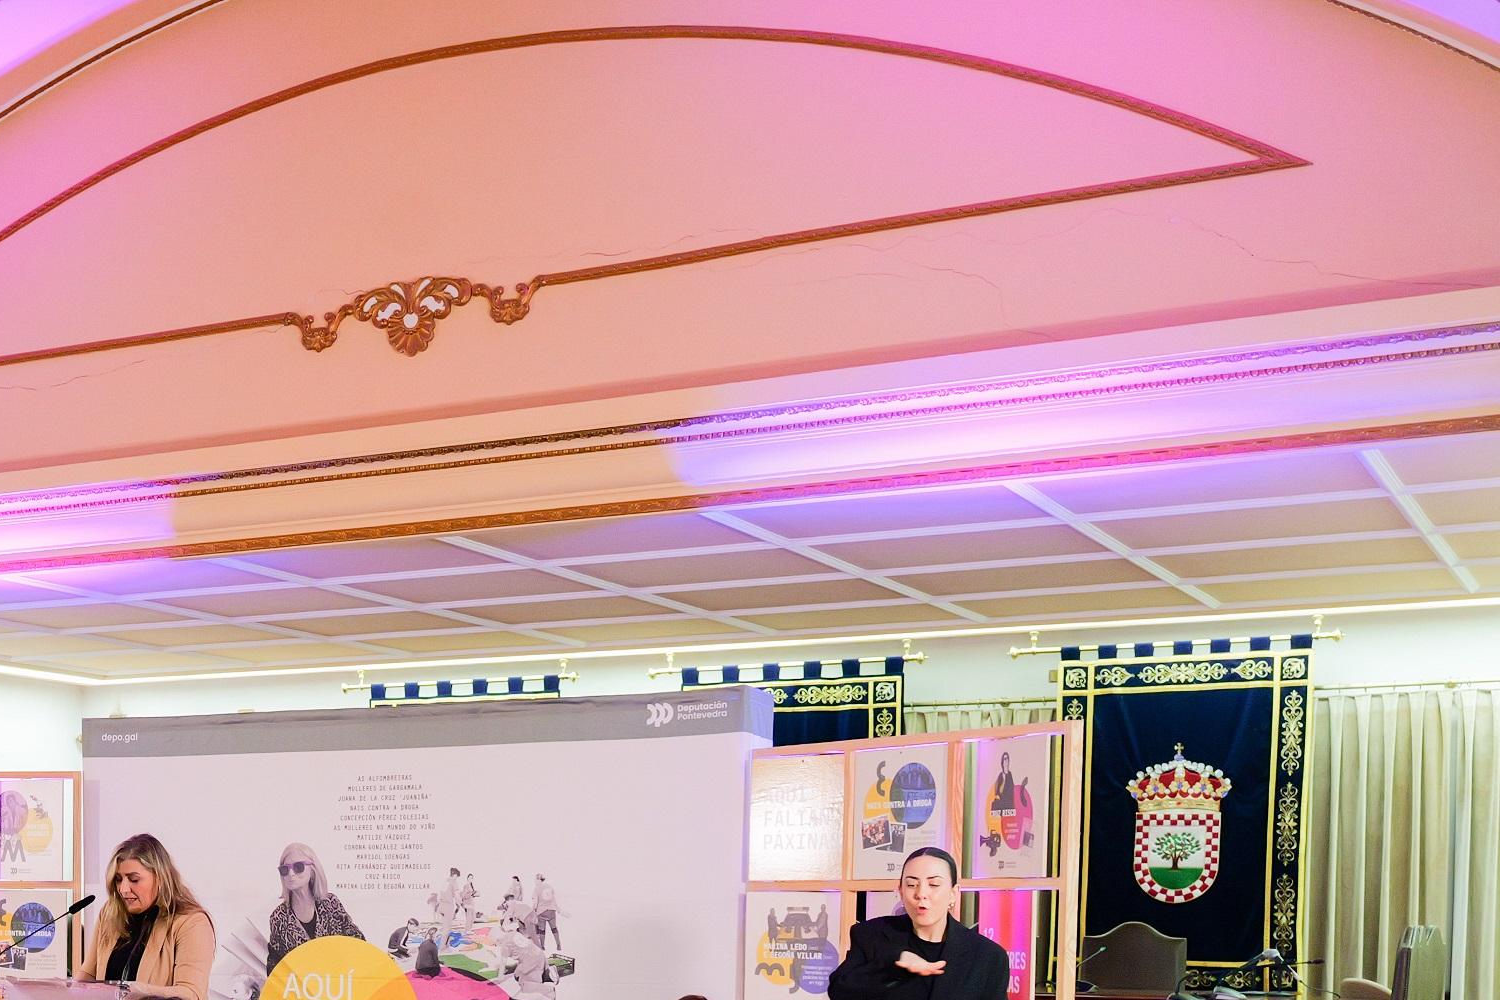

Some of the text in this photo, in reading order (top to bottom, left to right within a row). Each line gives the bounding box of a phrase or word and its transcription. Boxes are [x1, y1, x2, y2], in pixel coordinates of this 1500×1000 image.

[677, 701, 728, 713] Deputación
[677, 710, 728, 720] Pontevedra
[101, 733, 138, 743] depo.gal
[790, 943, 808, 951] LEDO
[796, 952, 823, 960] VILLAR
